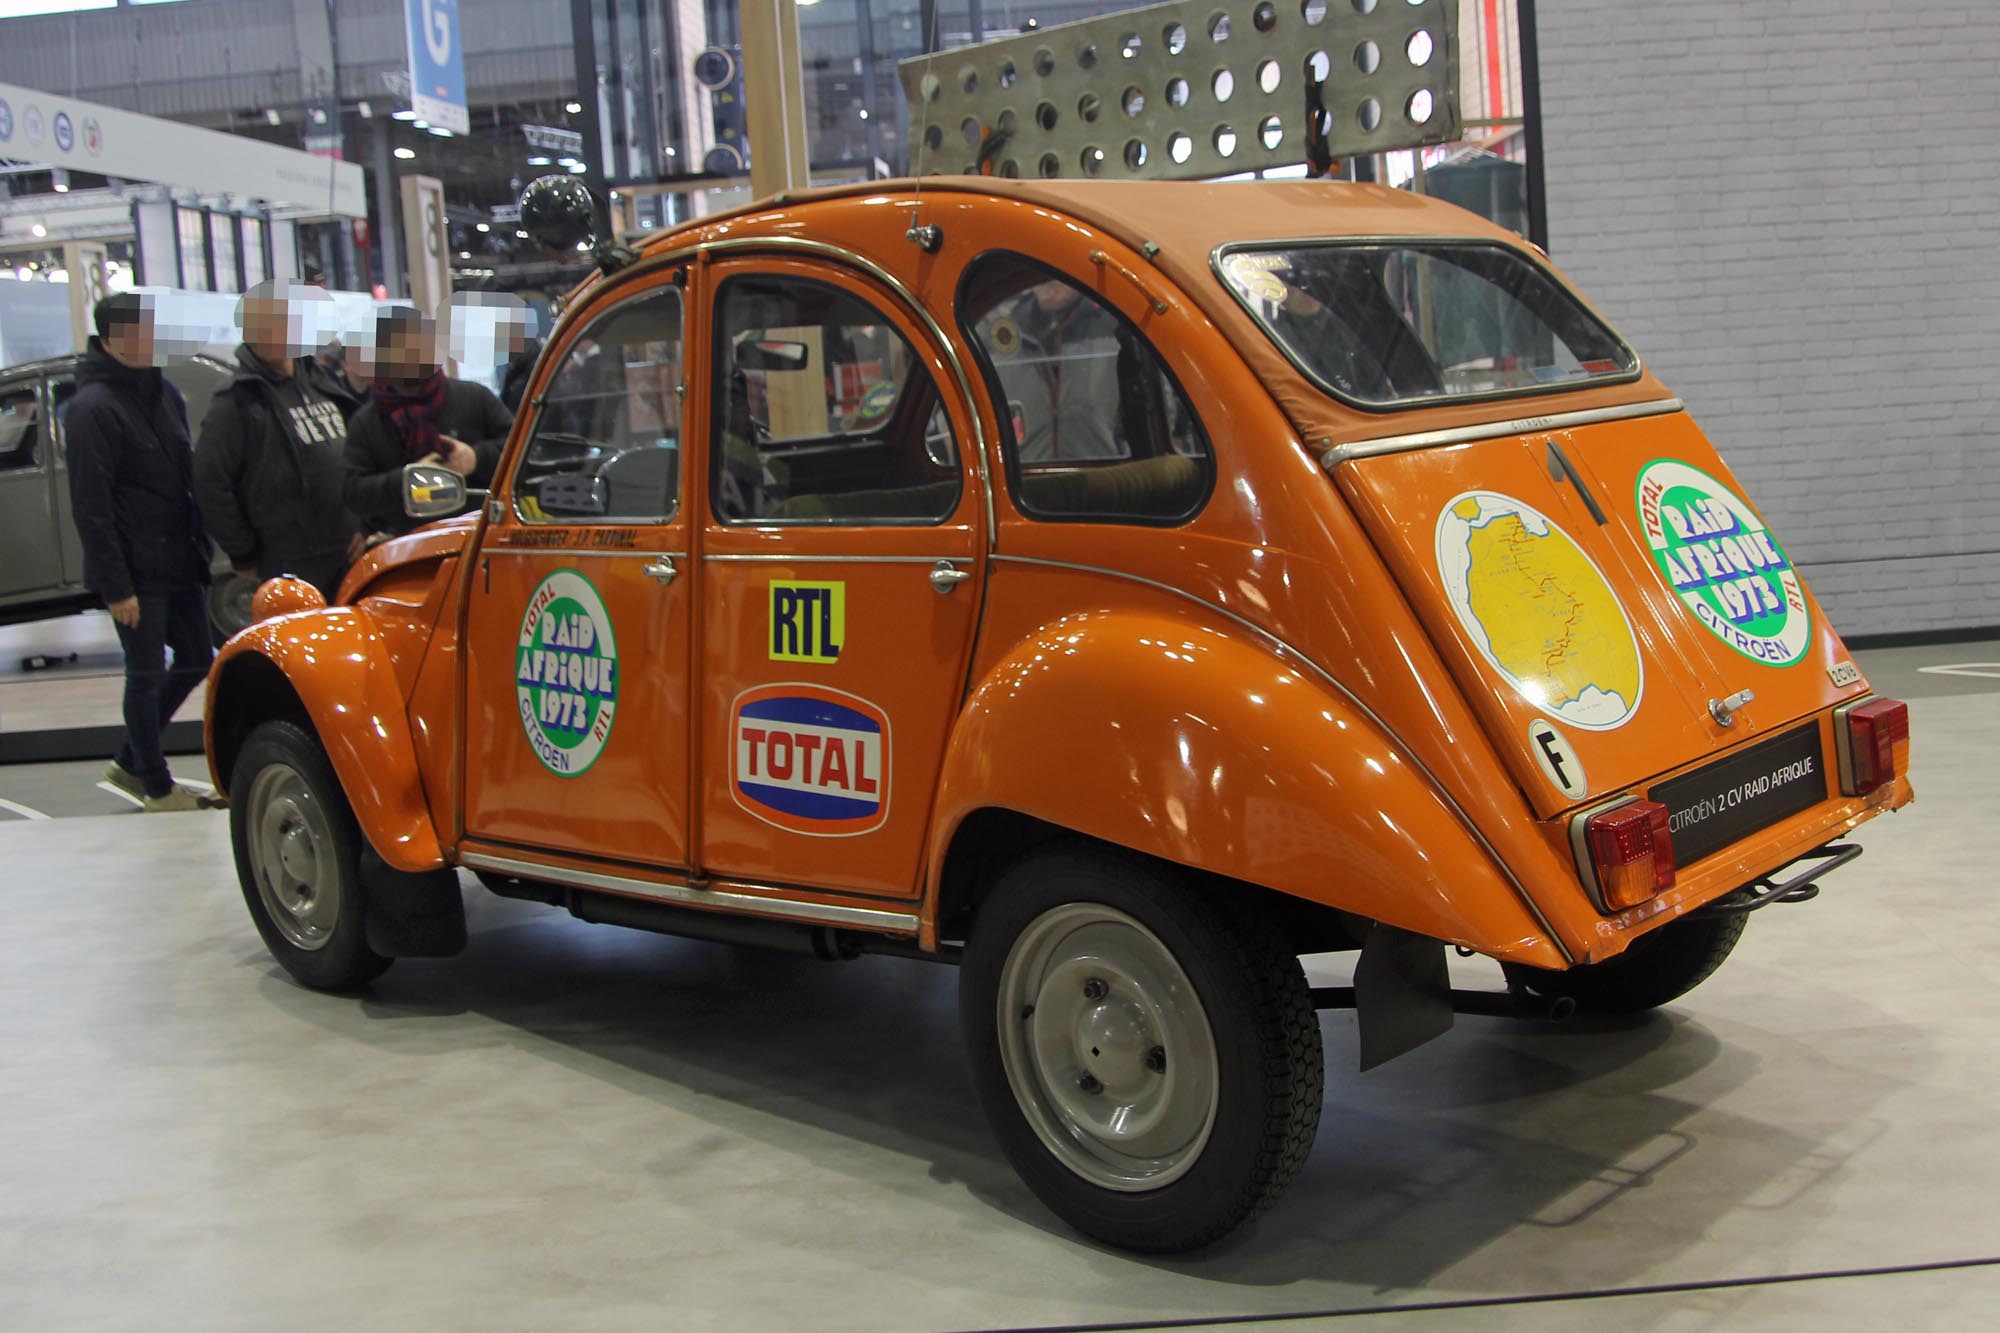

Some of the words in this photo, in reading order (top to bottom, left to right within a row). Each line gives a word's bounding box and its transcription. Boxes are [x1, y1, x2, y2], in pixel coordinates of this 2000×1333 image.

[422, 0, 451, 67] G
[1642, 477, 1663, 537] TOTAL
[523, 583, 556, 637] TOTAL
[773, 587, 839, 658] RTL
[1710, 575, 1783, 622] 1973
[1784, 580, 1804, 613] RTL
[540, 689, 588, 733] 1973
[593, 709, 611, 742] RTL
[742, 727, 877, 794] TOTAL
[1536, 731, 1572, 789] F
[1718, 794, 1726, 812] 2
[1727, 786, 1743, 807] CV
[1744, 776, 1770, 800] RAID
[1771, 756, 1814, 789] AFRIQUE
